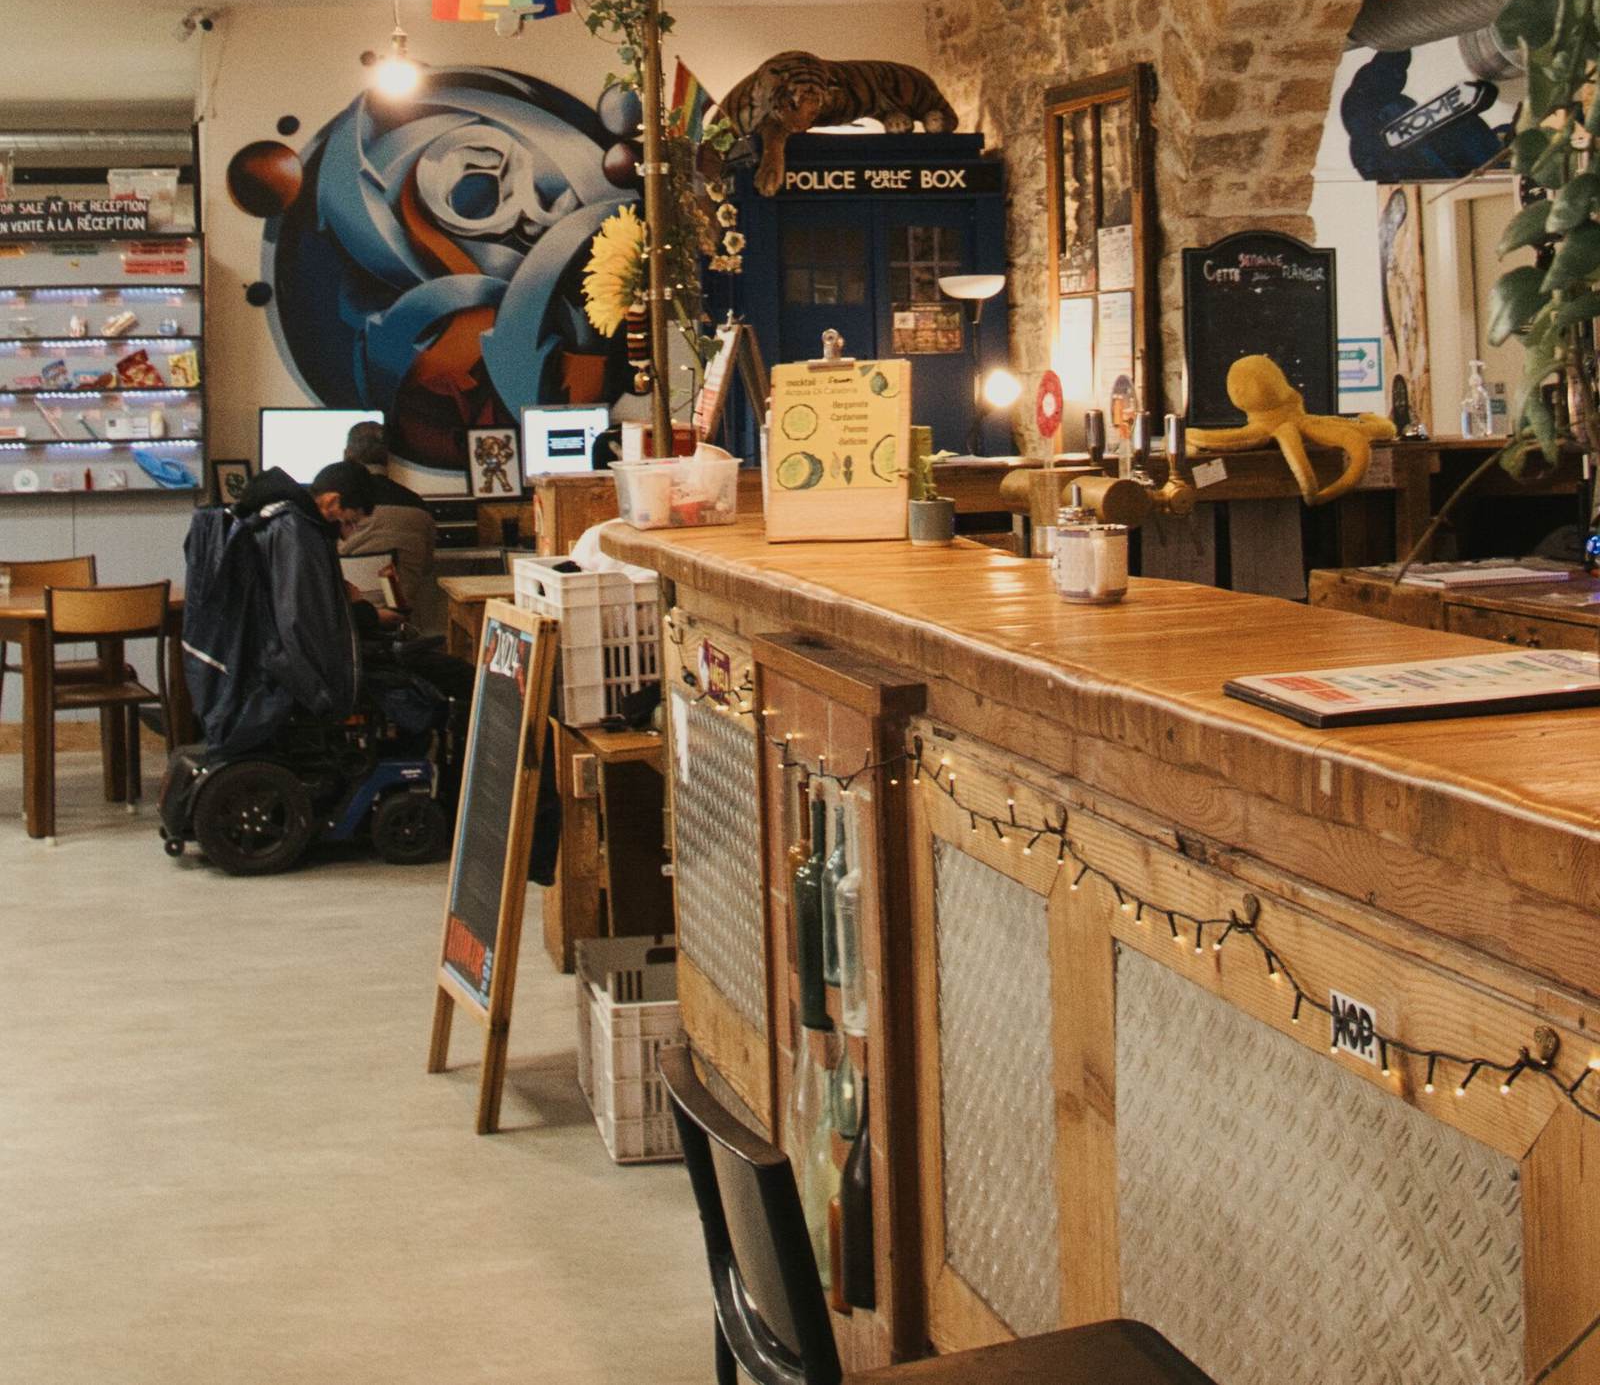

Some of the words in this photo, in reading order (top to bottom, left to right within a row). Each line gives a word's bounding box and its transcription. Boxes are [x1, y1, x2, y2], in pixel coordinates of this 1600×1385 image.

[1389, 88, 1465, 139] ROME
[786, 171, 856, 190] POLICE
[864, 170, 912, 180] PUBLIC
[920, 170, 967, 189] BOX
[871, 180, 907, 189] CALL
[0, 203, 14, 215] OR
[20, 202, 44, 214] SALE
[50, 201, 63, 213] AT
[69, 201, 86, 212] THE
[90, 199, 147, 212] RECEPTION
[10, 219, 44, 232] VENTE
[58, 217, 73, 231] LA
